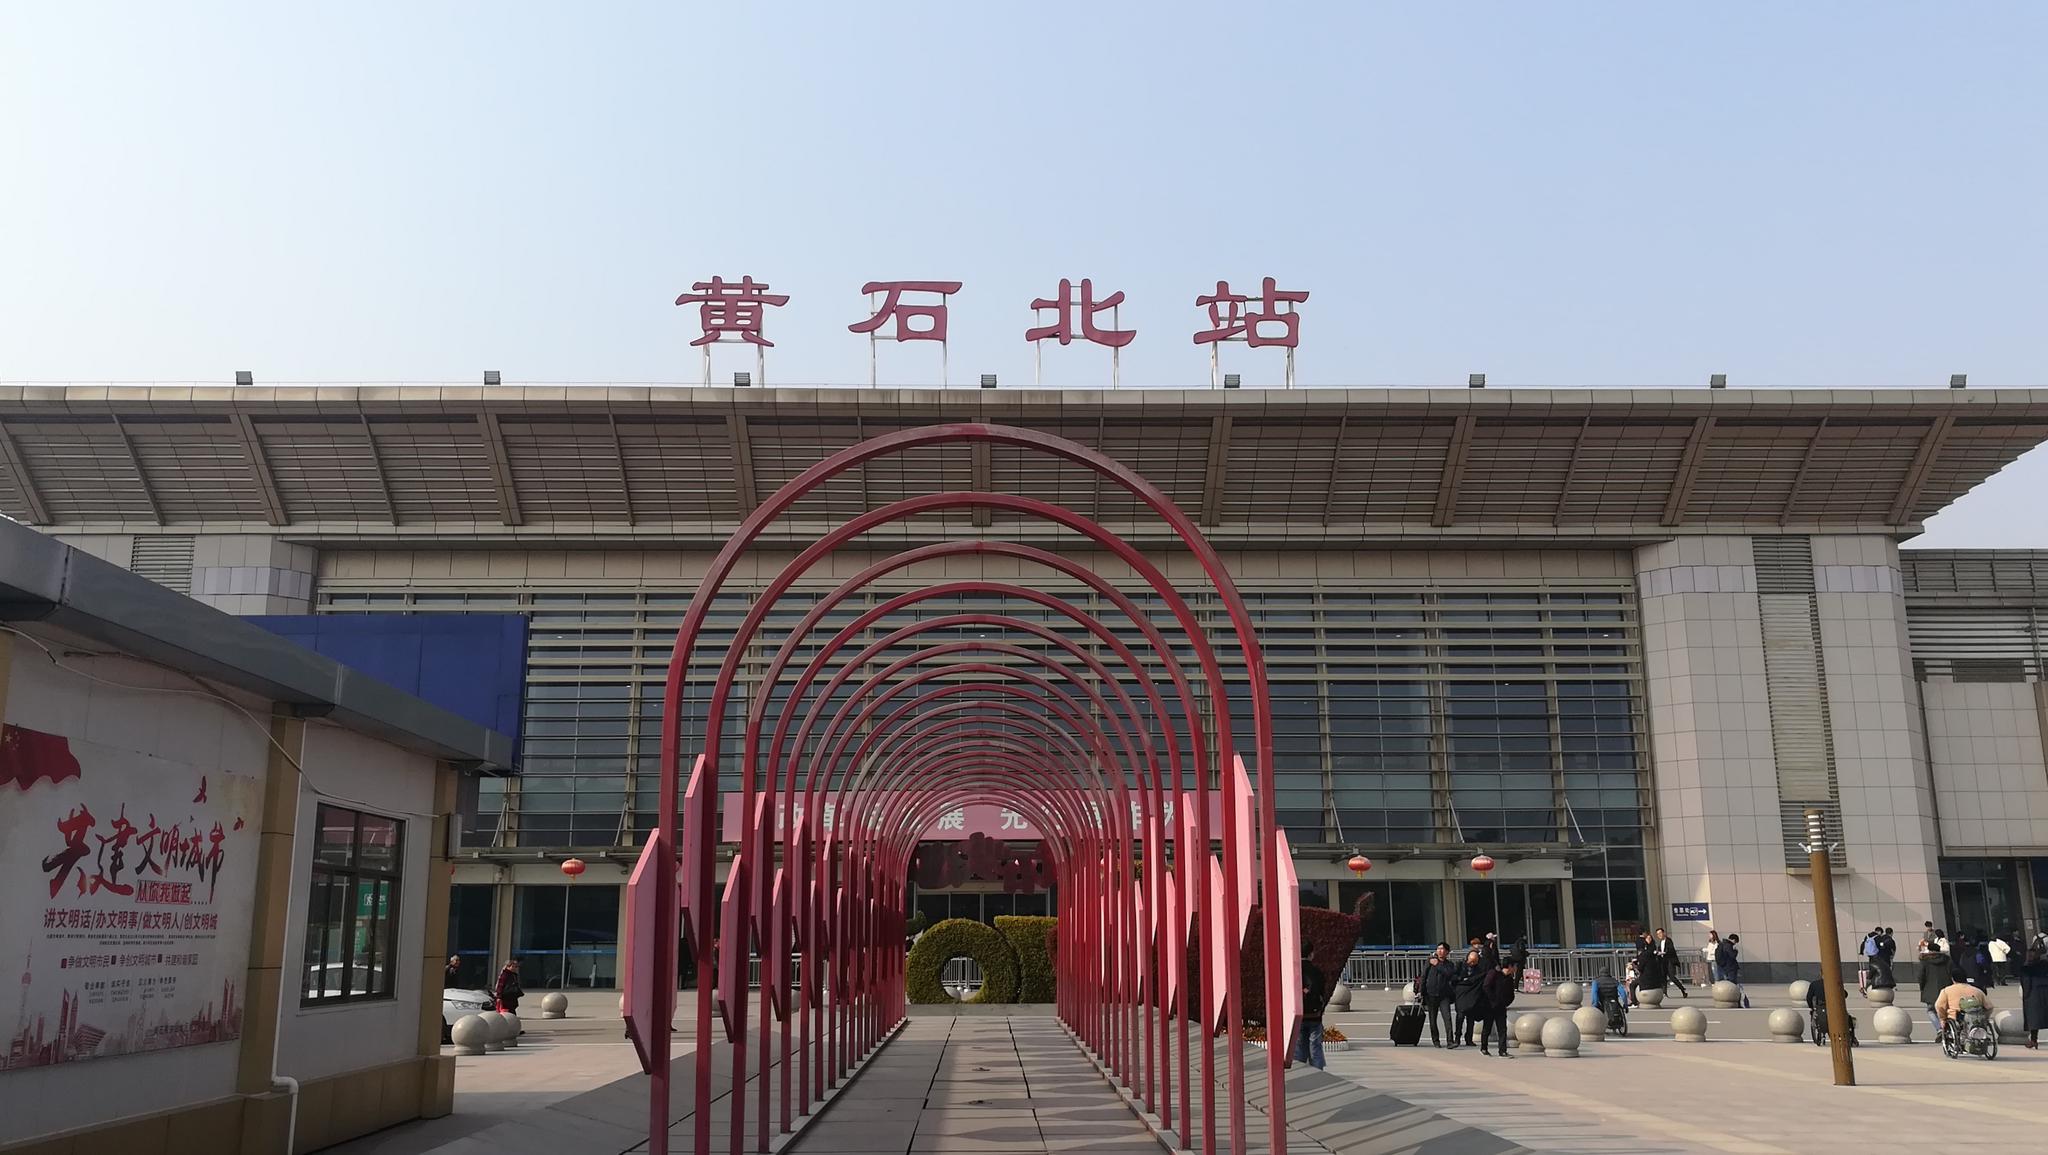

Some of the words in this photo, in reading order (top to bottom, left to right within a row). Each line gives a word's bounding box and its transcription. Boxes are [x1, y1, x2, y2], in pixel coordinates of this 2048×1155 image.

[675, 275, 1309, 349] 黄石北站
[42, 802, 226, 904] 共建文明城市
[43, 908, 218, 931] 讲文明话/办文明事/做文明人/创文明城
